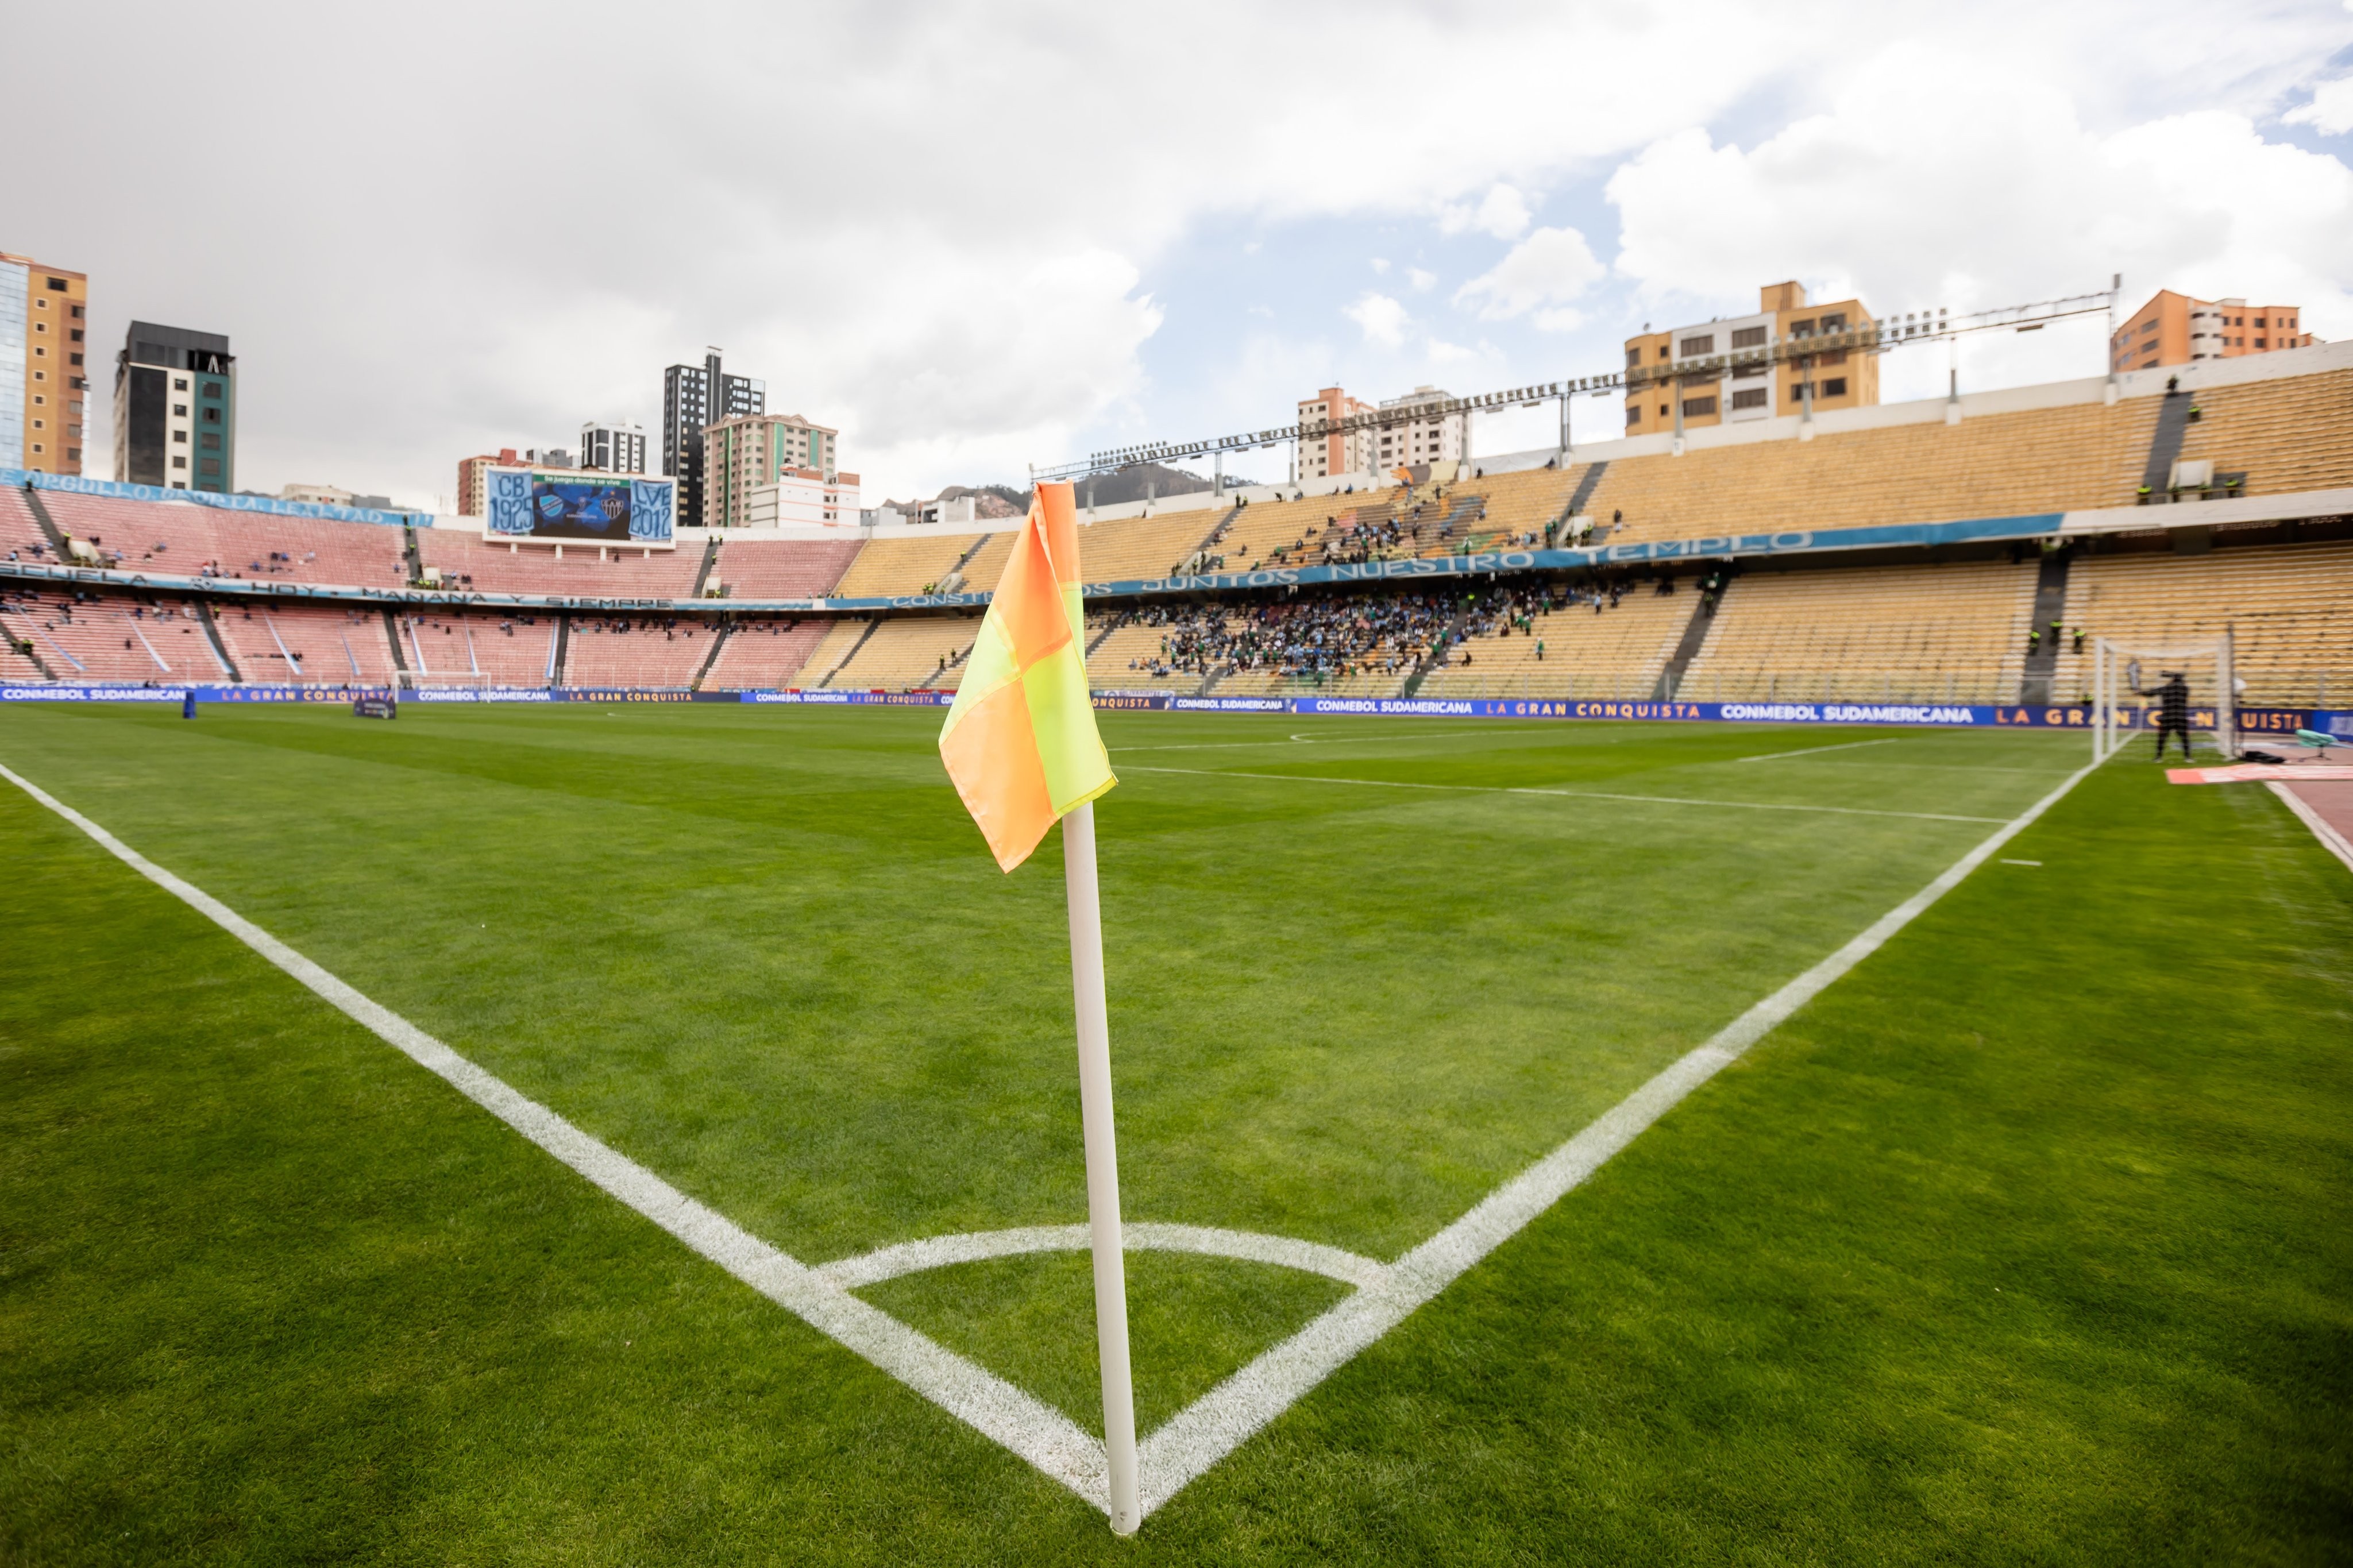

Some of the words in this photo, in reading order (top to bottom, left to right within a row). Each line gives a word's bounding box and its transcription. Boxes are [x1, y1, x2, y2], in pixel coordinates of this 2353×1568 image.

[499, 476, 525, 497] CB
[489, 496, 533, 530] 1925
[631, 504, 672, 538] 2012
[1141, 569, 1300, 591] JUNTOS
[1330, 552, 1534, 580] NUESTRO
[1579, 531, 1814, 565] TEMPLO
[510, 594, 524, 604] Y
[546, 597, 672, 609] SIEMPRE
[2, 689, 87, 700] CONMEBOL
[222, 691, 242, 700] LA
[250, 691, 296, 701] GRAN
[418, 691, 476, 701] CONMEBOL
[478, 691, 550, 701] SUDAMERICANA
[569, 693, 584, 701] LA
[589, 693, 622, 701] GRAN
[627, 693, 692, 702] CONQUISTA
[756, 693, 801, 702] CONMEBOL
[803, 694, 848, 702] SUDAMERICANA
[864, 696, 884, 704] GRAN
[888, 696, 934, 705] CONQUISTA
[1092, 698, 1150, 708] ONQUISTA
[1176, 698, 1220, 709] CONMEBOL
[1221, 700, 1283, 710] SUDAMERICANA
[1316, 700, 1378, 712] CONMEBOL
[1381, 701, 1473, 714] SUDAMERICANA
[1486, 703, 1507, 715] LA
[1515, 703, 1567, 716] GRAN
[1576, 704, 1700, 719] CONQUISTA
[1721, 704, 1820, 721] CONMEBOL
[1823, 705, 1974, 723] SUDAMERICANA
[1996, 708, 2031, 724] LA
